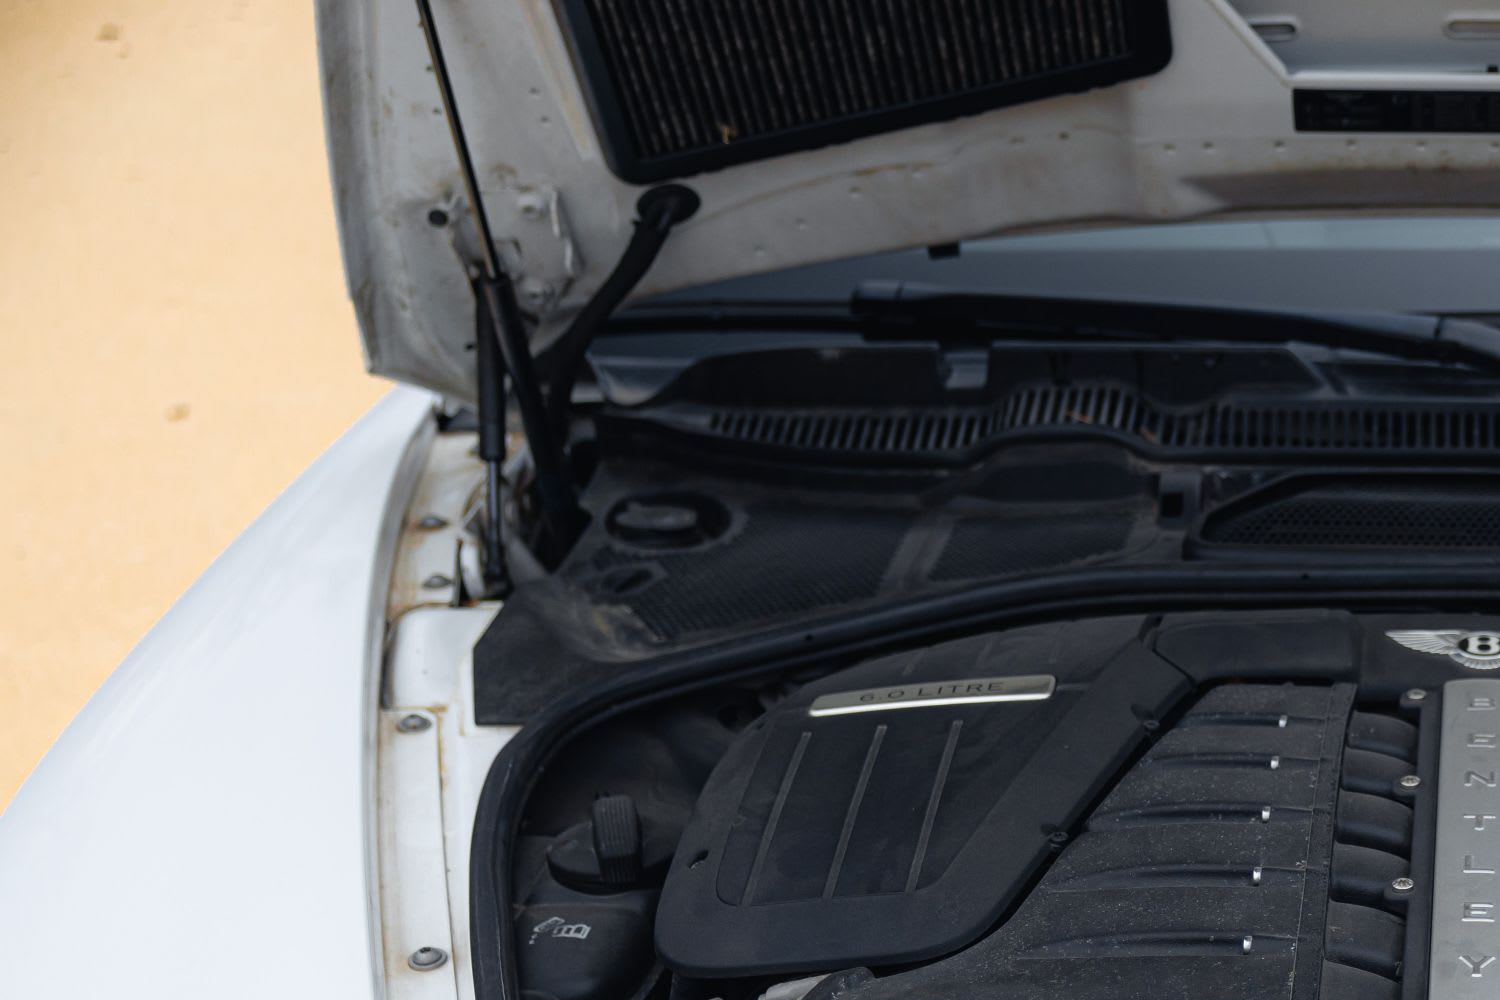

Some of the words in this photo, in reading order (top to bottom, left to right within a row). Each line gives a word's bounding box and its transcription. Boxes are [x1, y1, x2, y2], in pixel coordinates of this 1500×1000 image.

[859, 689, 906, 703] 6.0
[917, 681, 1005, 696] LITRE
[1458, 696, 1498, 979] BENTLEY
